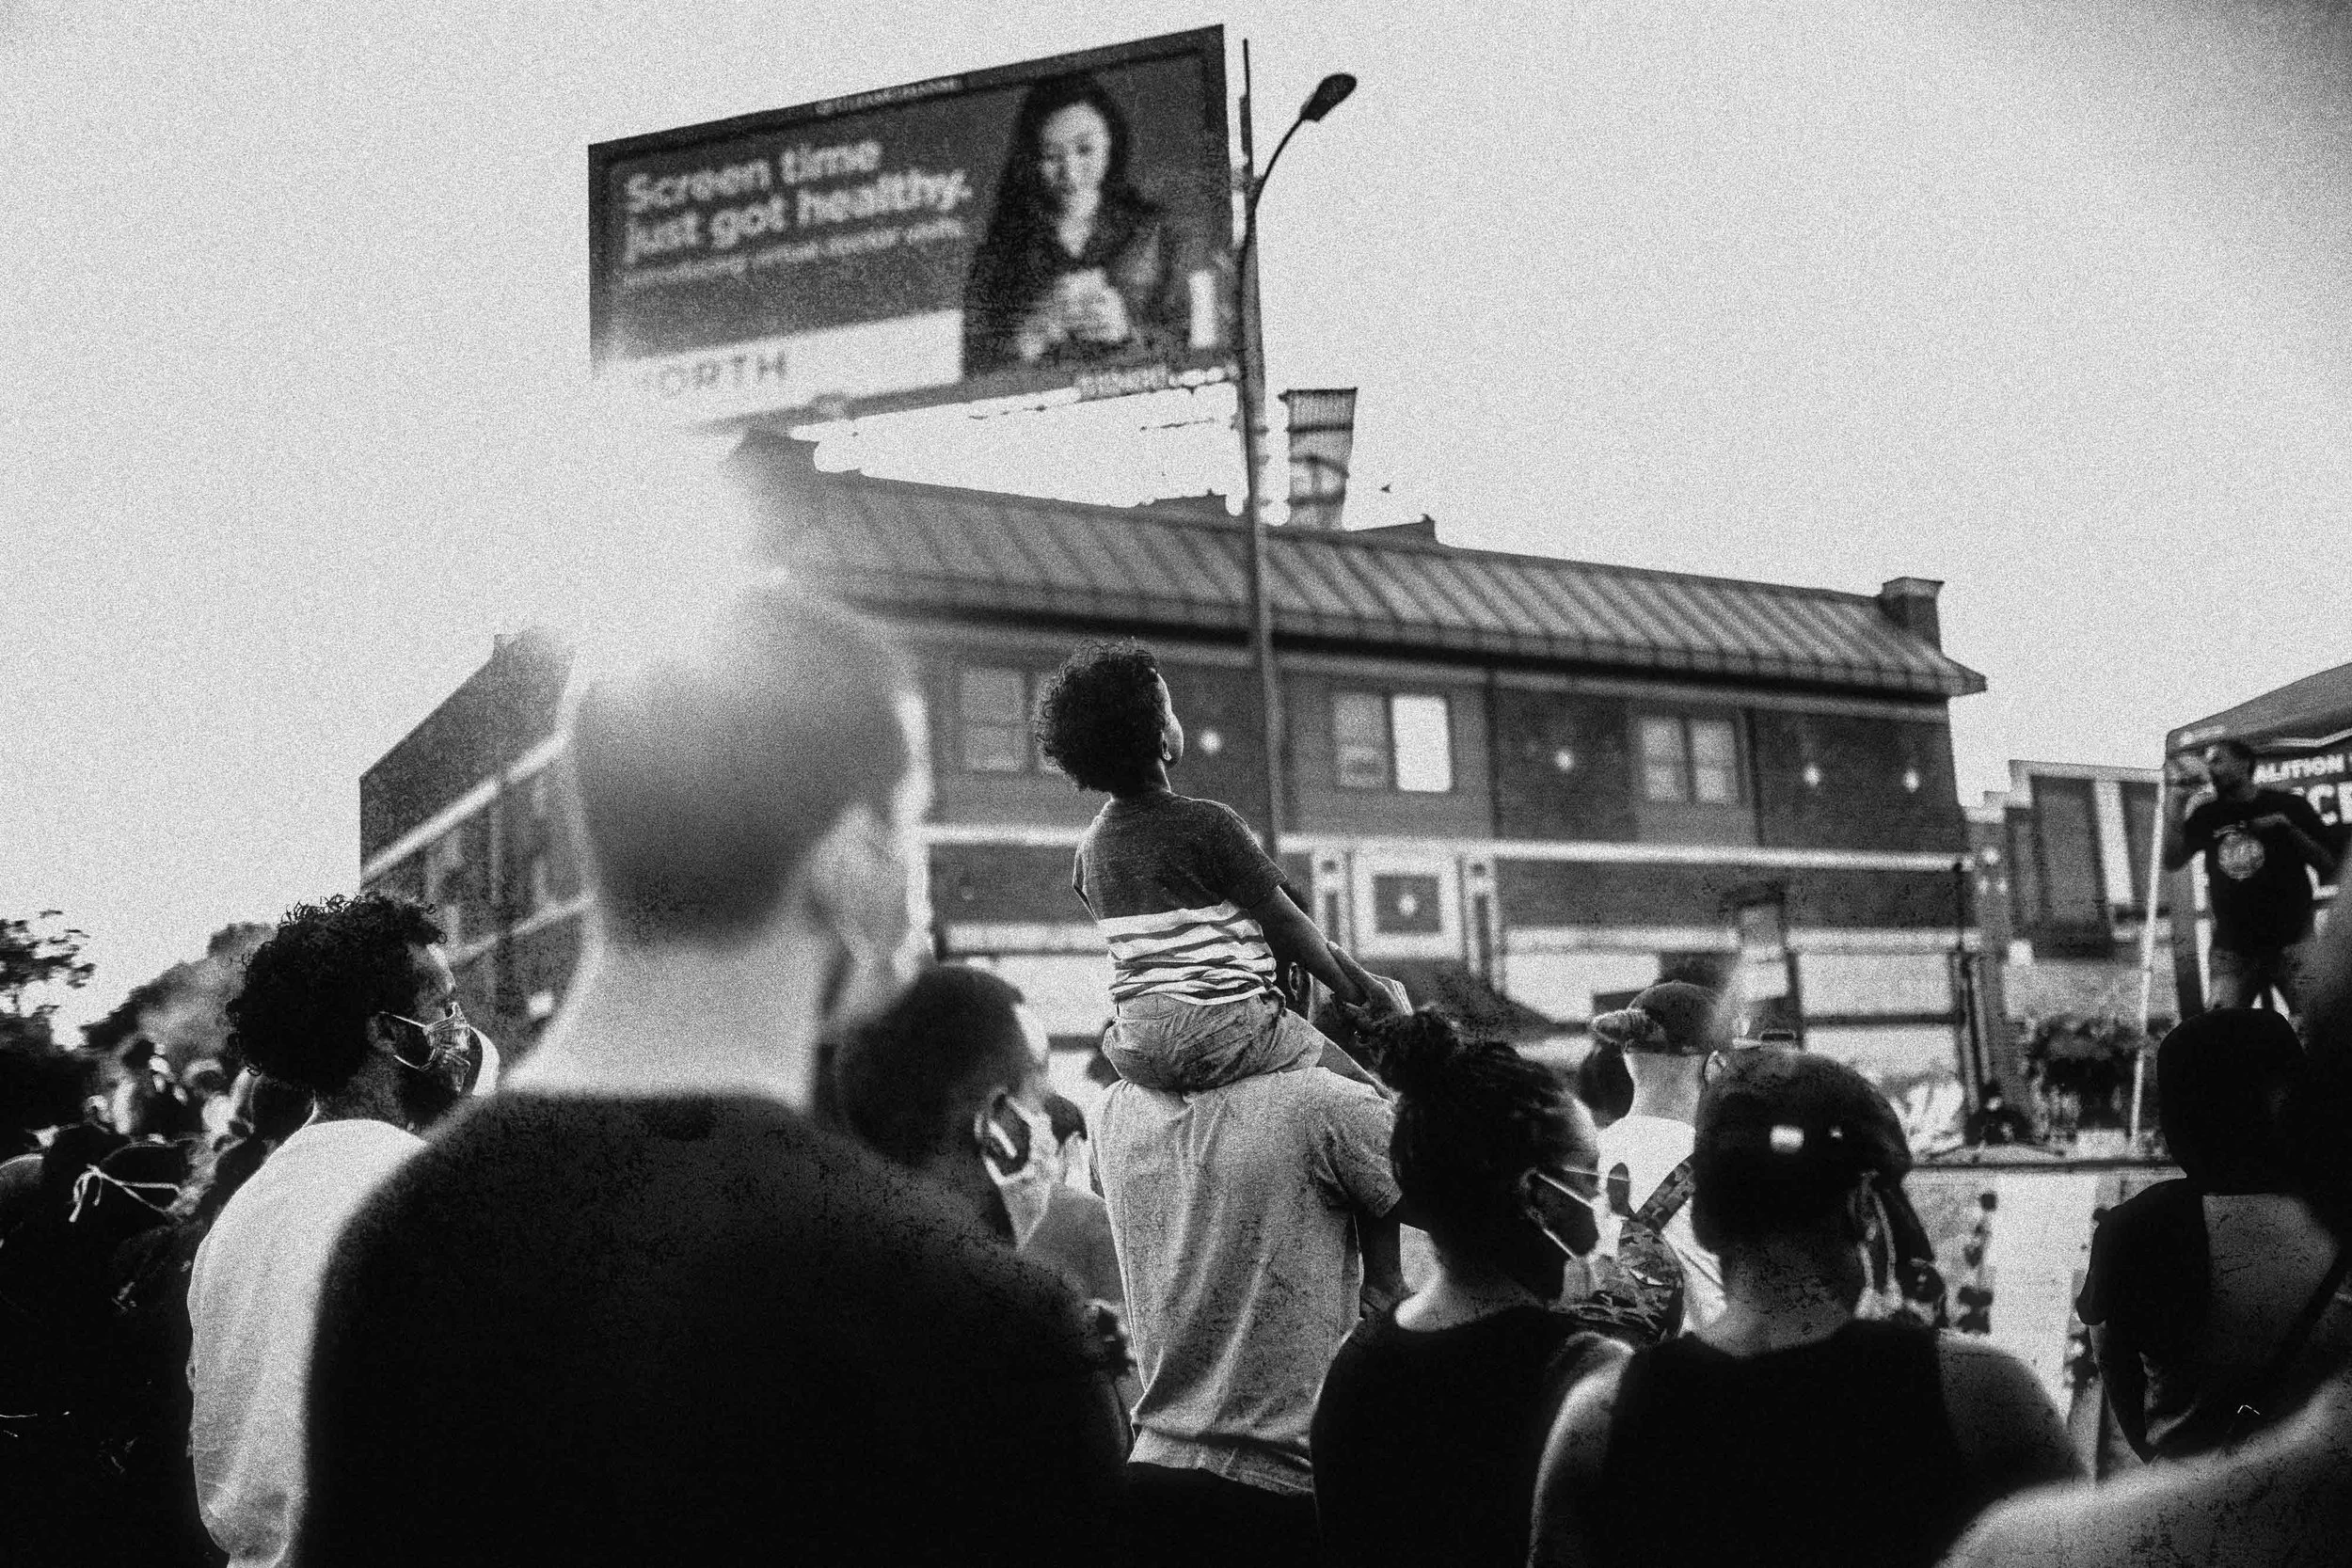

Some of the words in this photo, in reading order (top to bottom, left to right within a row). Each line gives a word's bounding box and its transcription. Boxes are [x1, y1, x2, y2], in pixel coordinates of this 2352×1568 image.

[626, 159, 771, 214] Screen
[780, 139, 882, 184] time
[624, 210, 701, 264] just
[708, 194, 787, 249] got
[796, 169, 973, 228] healthy.
[640, 351, 788, 400] ORTH
[2251, 753, 2345, 784] ALITION
